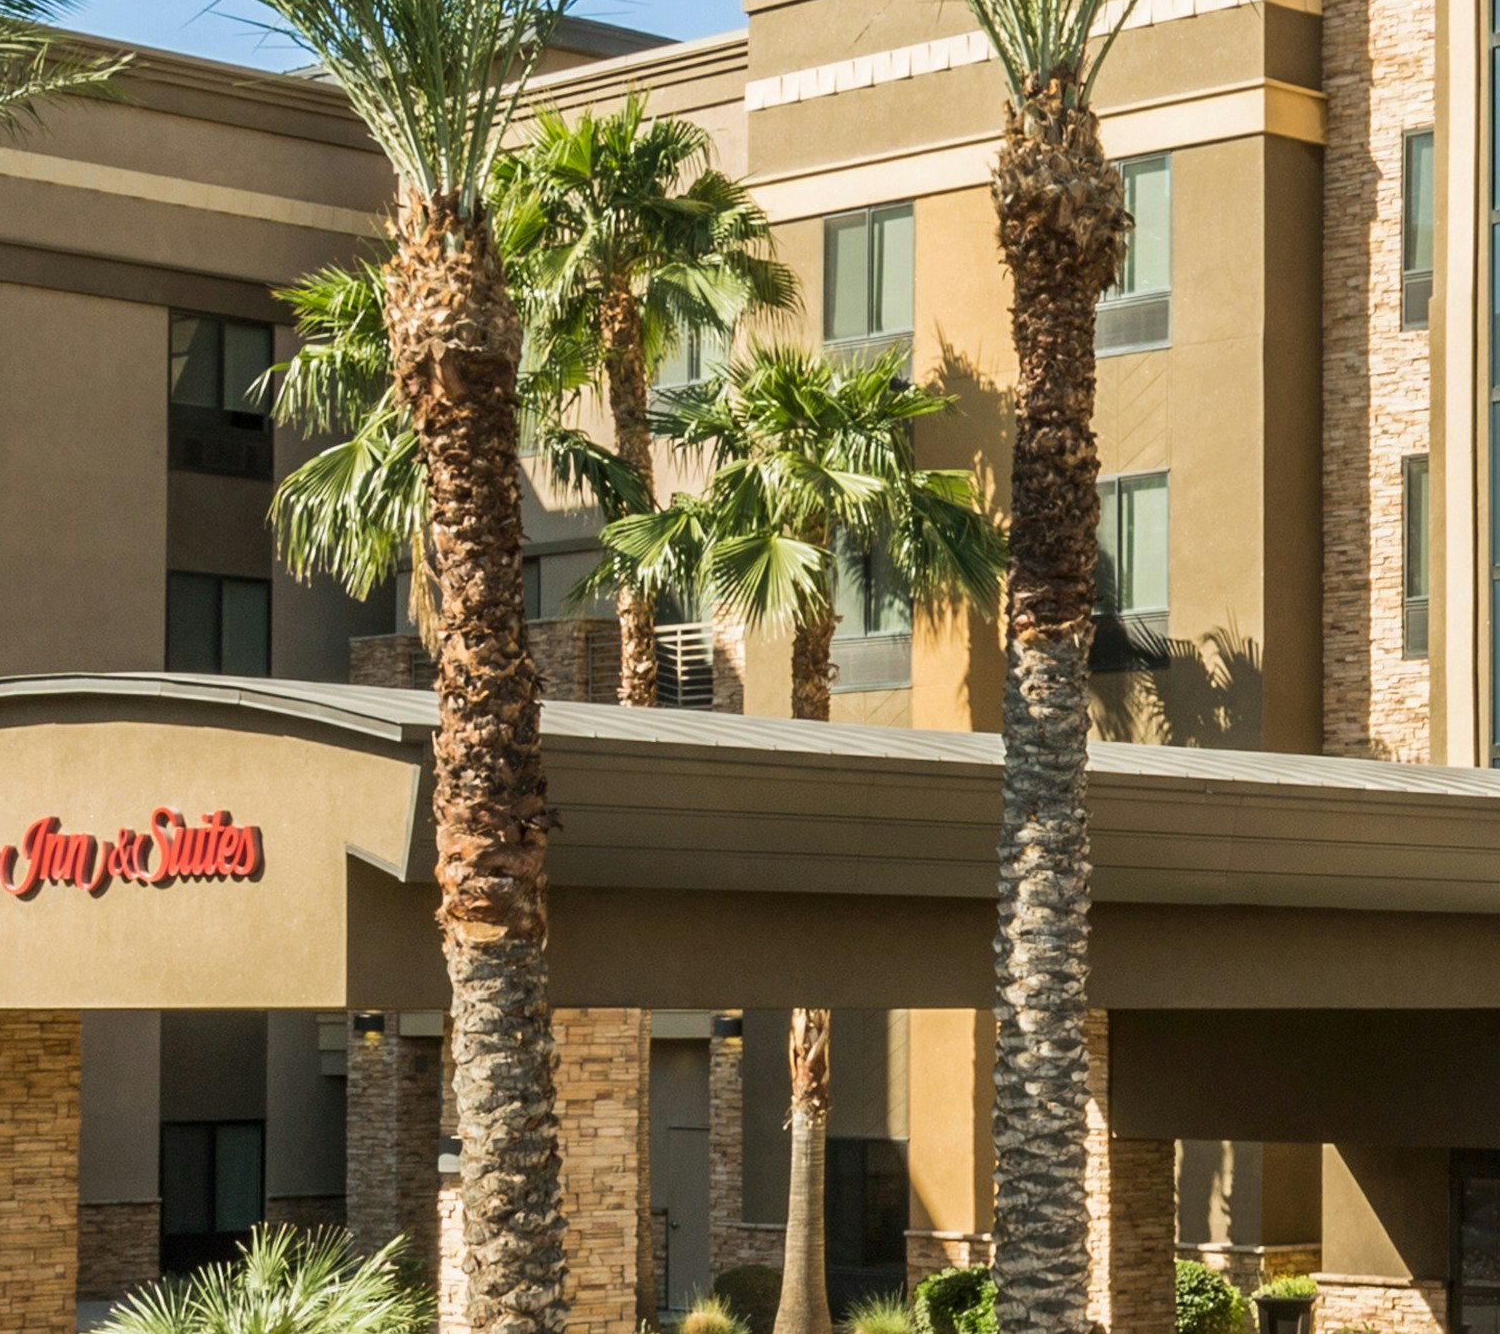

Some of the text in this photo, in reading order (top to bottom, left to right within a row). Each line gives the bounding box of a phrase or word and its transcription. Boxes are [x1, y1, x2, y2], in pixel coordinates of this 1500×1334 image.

[0, 816, 110, 896] Inn
[108, 827, 141, 881] &
[132, 806, 260, 884] Suites
